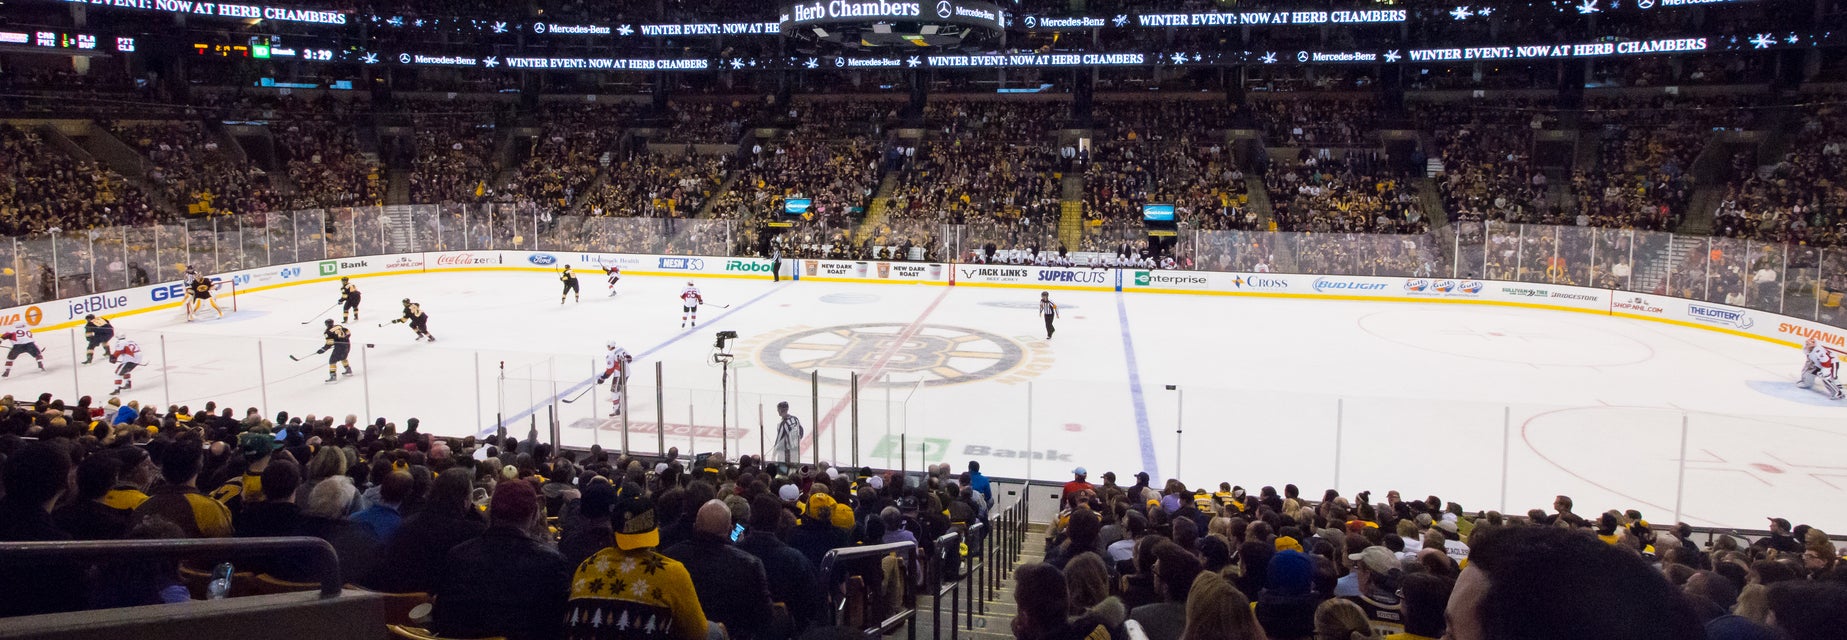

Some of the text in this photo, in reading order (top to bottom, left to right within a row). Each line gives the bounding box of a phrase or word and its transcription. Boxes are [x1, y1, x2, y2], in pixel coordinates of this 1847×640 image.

[155, 0, 192, 13] NOW
[193, 3, 215, 14] AT
[218, 4, 261, 18] HERB
[264, 7, 346, 25] CHAMBERS
[795, 0, 920, 22] Herb Chambers
[955, 6, 995, 21] Mercedes-Benz
[1041, 10, 1407, 28] Mercedes-Benz WINTER EVENT: NOW AT HERB CHAMBERS
[549, 23, 780, 35] Mercedes-Benz WINTER EVENT: NOW AT HE
[303, 48, 333, 61] 3:29
[1313, 38, 1707, 62] Mercedes-Benz WINTER EVENT: NOW AT HERB CHAMBERS
[415, 55, 708, 69] Mercedes-Benz WINTER EVENT: NOW AT HERB CHAMBERS
[848, 54, 1144, 67] Mercedes-Benz WINTER EVENT: NOW AT HERB CHAMBERS
[341, 260, 368, 270] Bank
[437, 252, 473, 266] Coca-Cola
[534, 254, 551, 265] Ford
[662, 257, 684, 269] NESN
[978, 267, 1028, 277] JACK LINK'S
[1037, 269, 1105, 284] SUPERCUTS
[1139, 274, 1207, 285] enterprise
[1247, 274, 1288, 288] CROSS
[1317, 280, 1389, 291] BUD LIGHT
[69, 294, 127, 320] jetBlue
[1691, 306, 1741, 321] THE LOTTERY
[1778, 322, 1846, 347] SYLVANIA
[963, 444, 1073, 463] Bank
